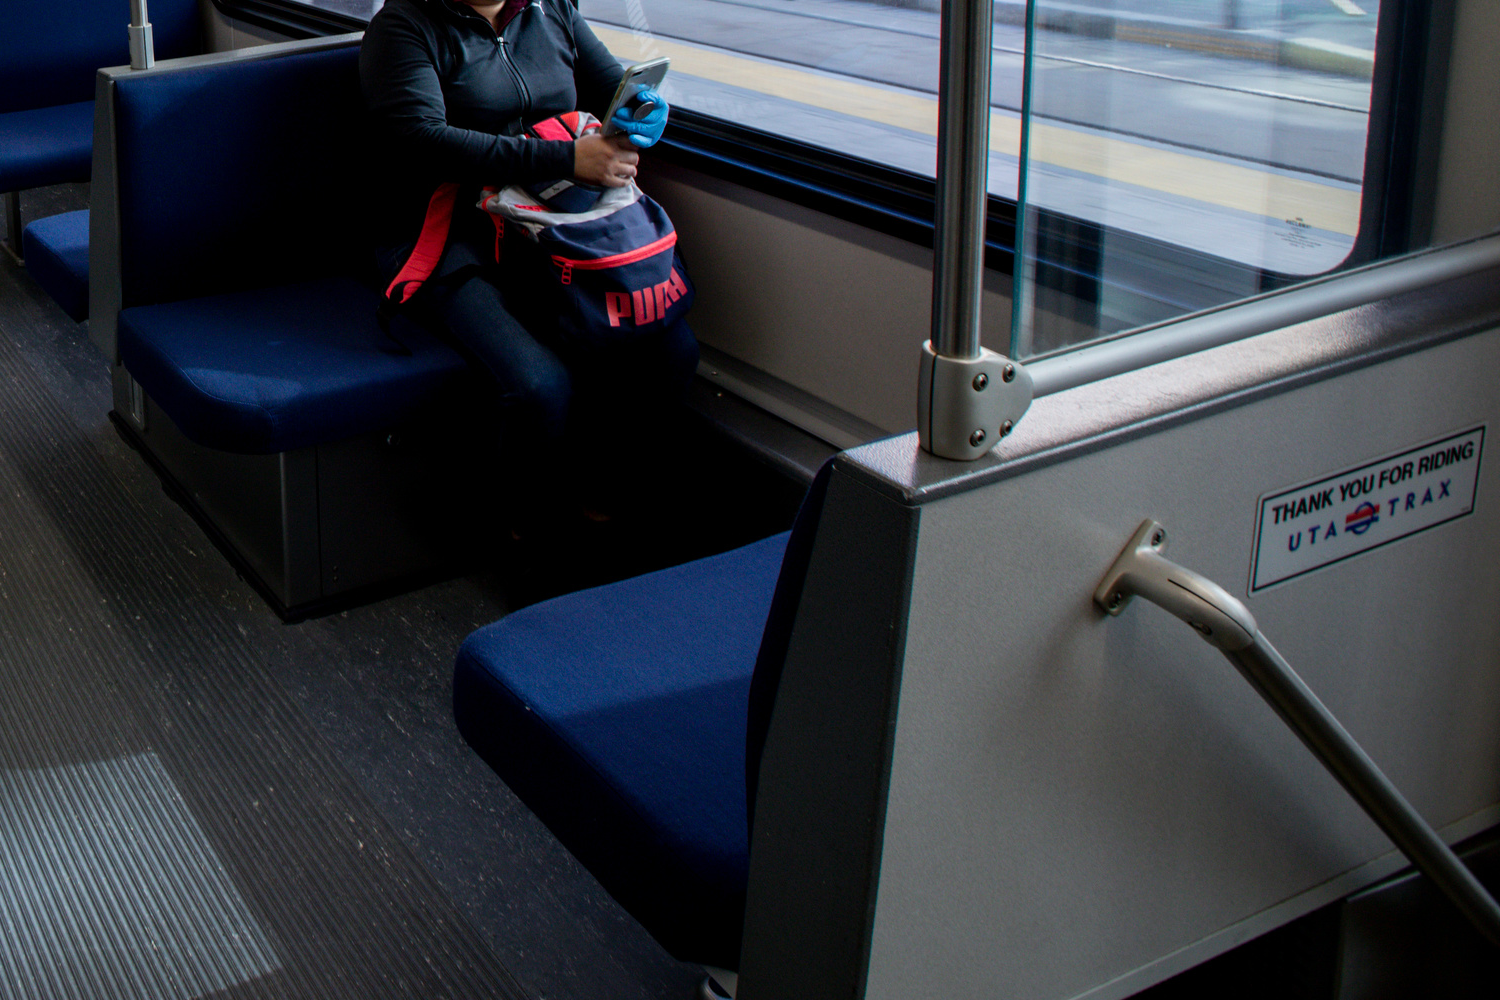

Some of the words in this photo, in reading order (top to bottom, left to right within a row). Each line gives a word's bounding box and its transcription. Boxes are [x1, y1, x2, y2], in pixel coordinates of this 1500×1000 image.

[1272, 488, 1334, 524] THANK
[1339, 474, 1375, 501] YOU
[1378, 462, 1414, 489] FOR
[1418, 441, 1474, 475] RIDING
[1288, 521, 1337, 551] UTA
[1388, 479, 1451, 516] TRAX
